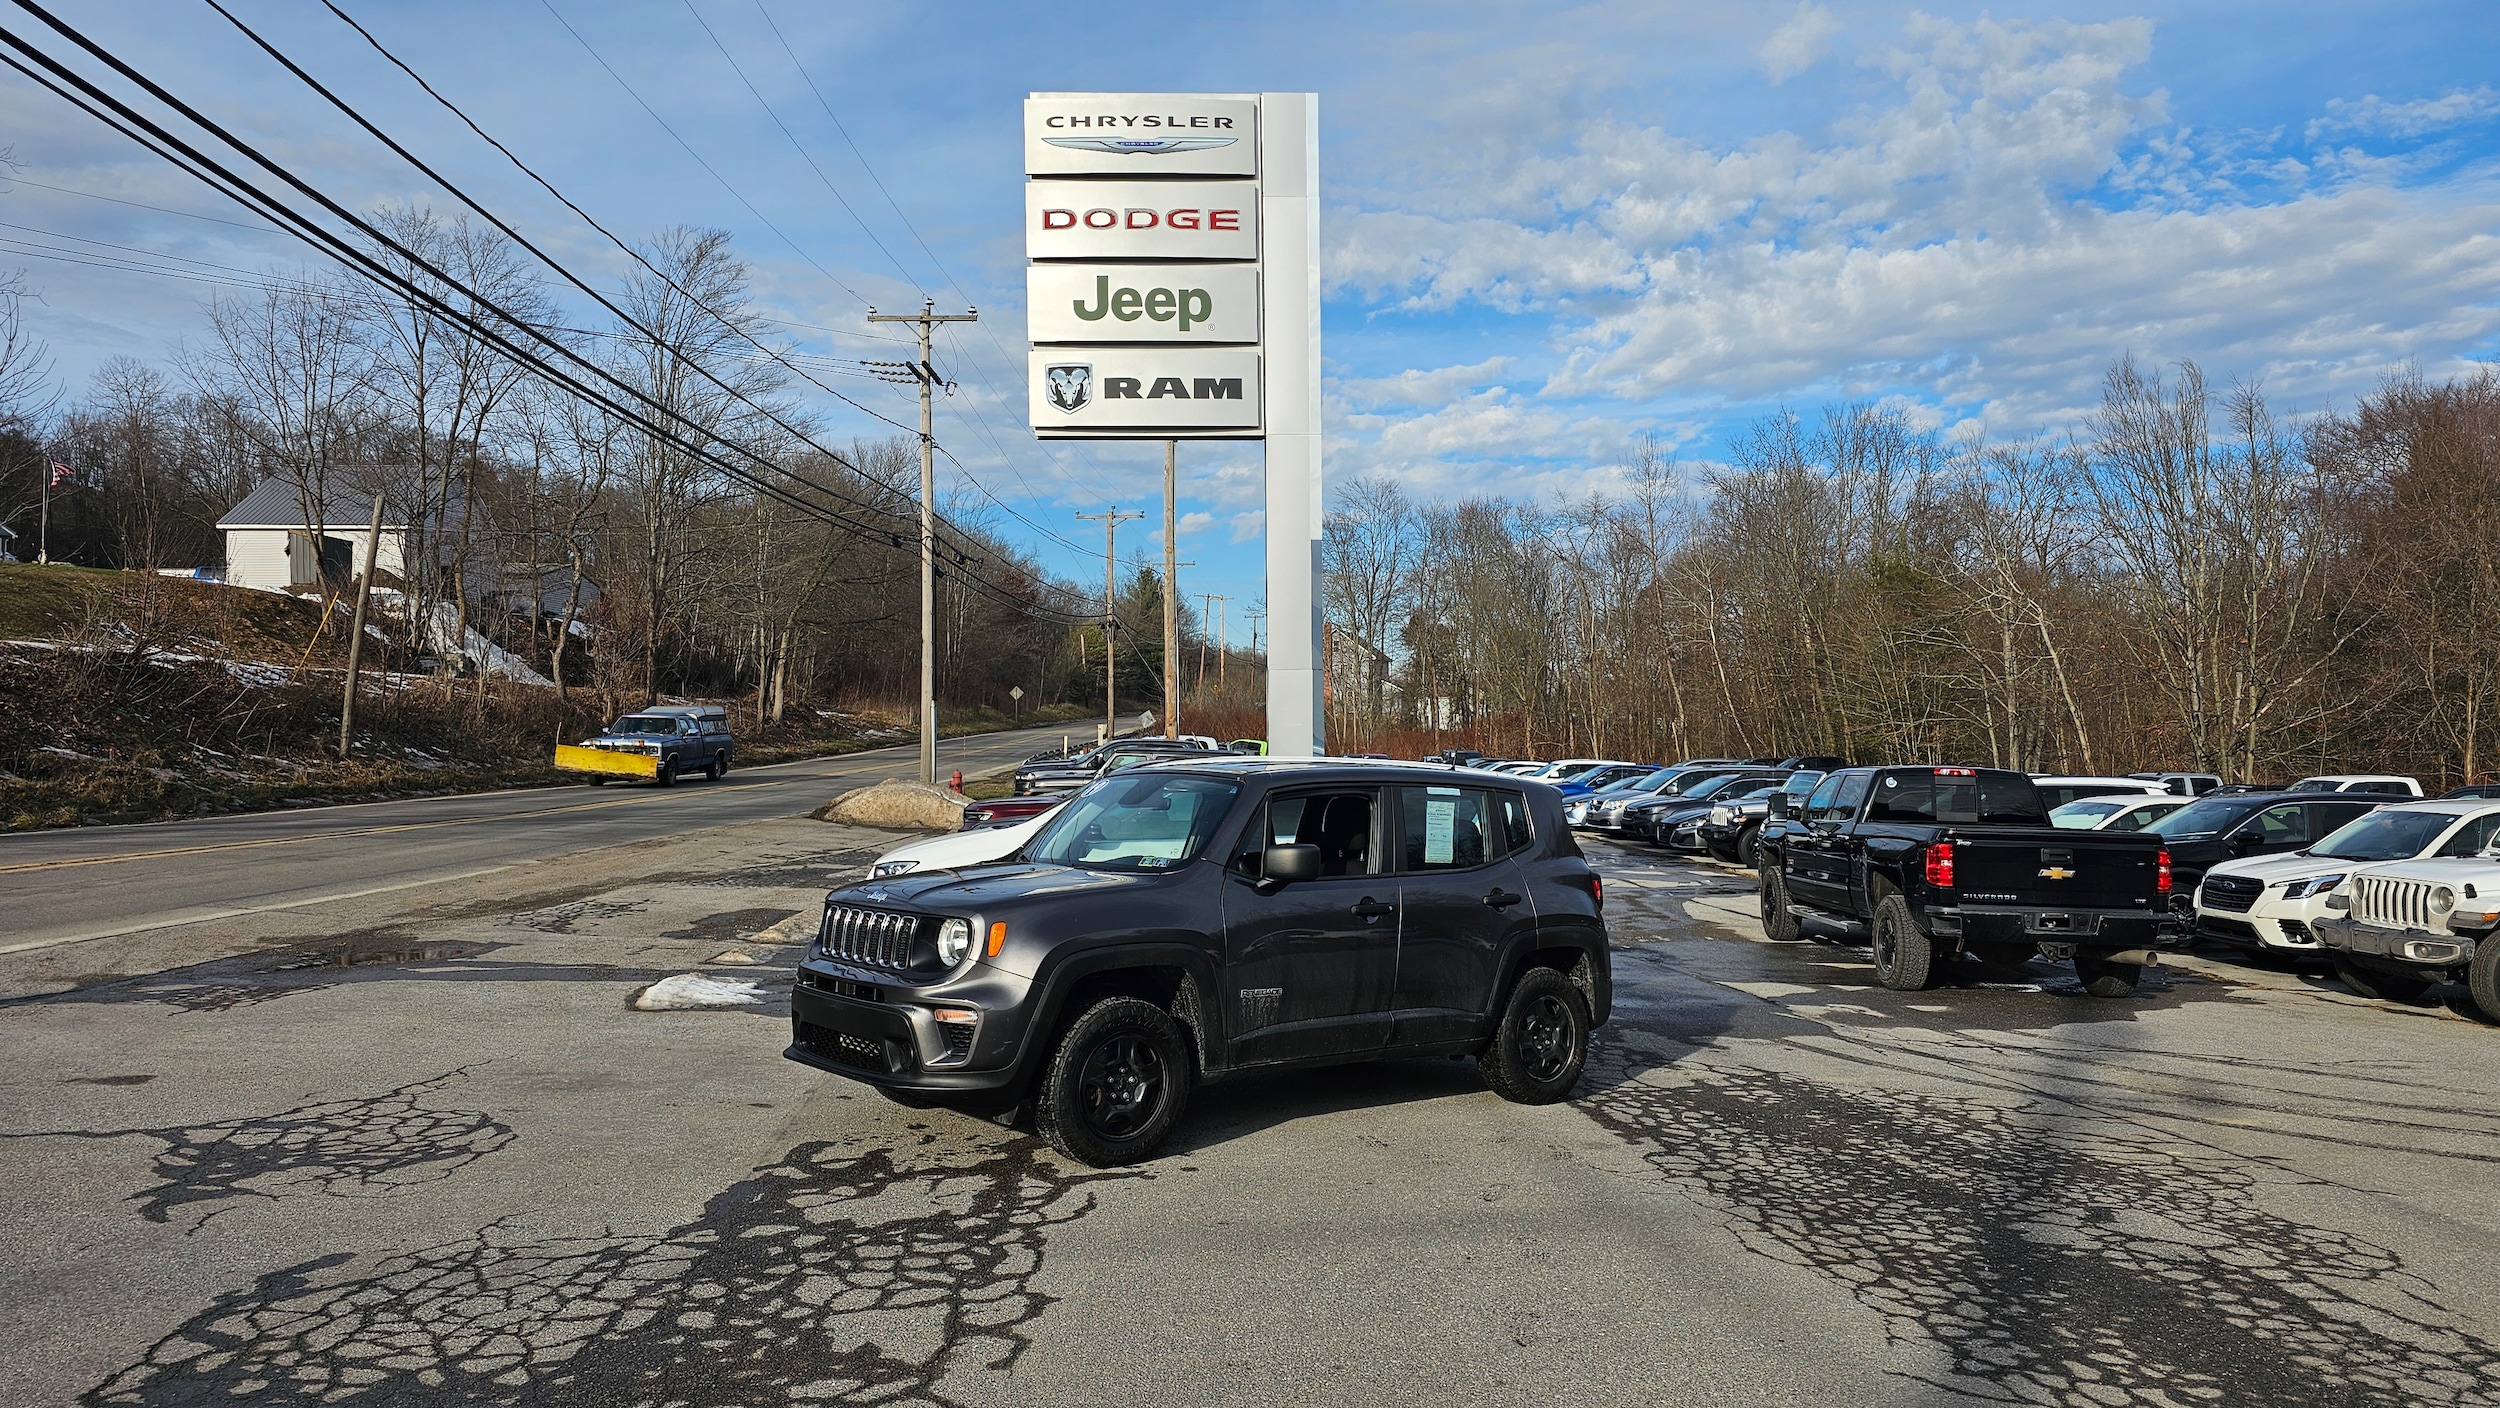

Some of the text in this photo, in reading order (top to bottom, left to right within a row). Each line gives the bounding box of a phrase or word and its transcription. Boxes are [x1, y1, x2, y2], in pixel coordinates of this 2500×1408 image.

[1046, 115, 1234, 129] CHRYSLER
[1042, 208, 1241, 231] DODGE
[1073, 275, 1212, 331] Jeep
[1104, 377, 1243, 400] RAM
[1962, 893, 2018, 901] SILVERADO
